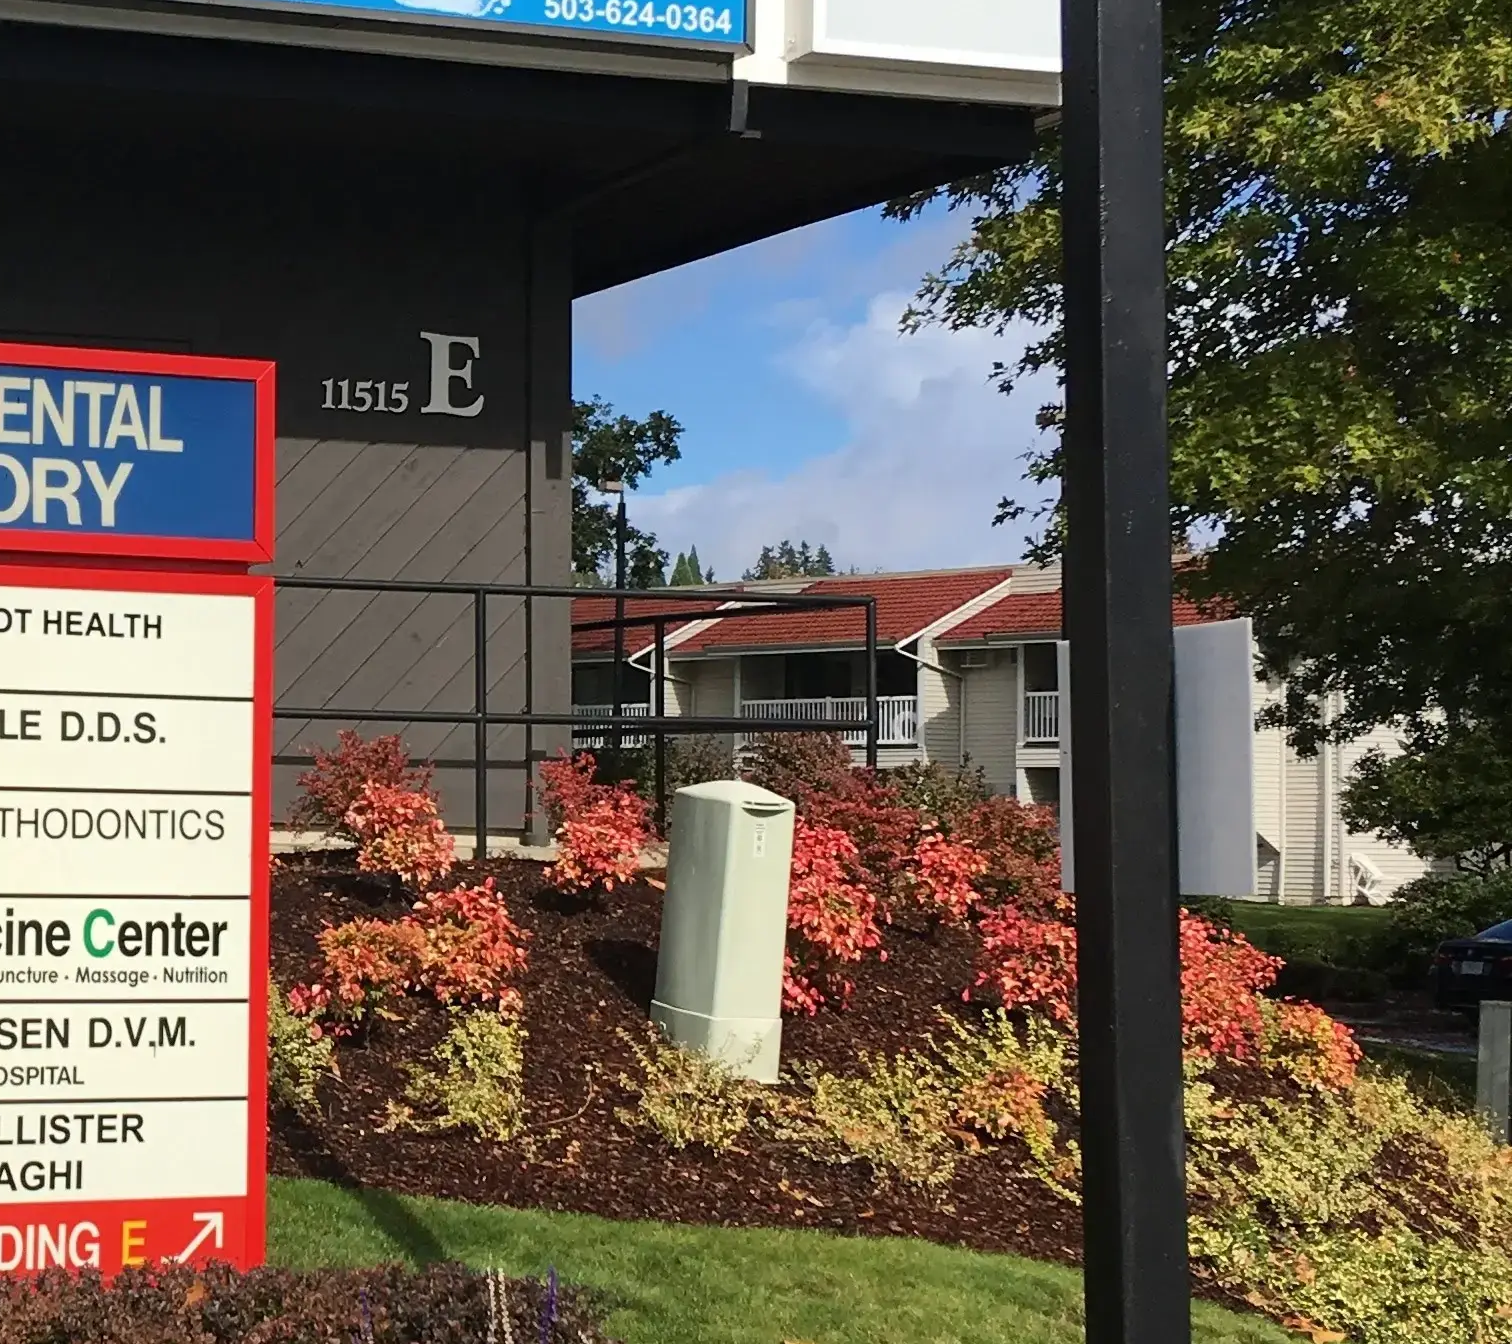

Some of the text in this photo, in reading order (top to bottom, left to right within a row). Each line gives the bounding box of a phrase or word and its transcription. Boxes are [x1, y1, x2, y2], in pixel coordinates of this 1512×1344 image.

[322, 332, 484, 416] 11515 E
[44, 610, 161, 638] HEALTH
[61, 711, 165, 743] D.D.S.
[84, 909, 227, 958] Center
[76, 967, 149, 987] Massage
[164, 967, 227, 983] Nutrition
[122, 1219, 148, 1265] E
